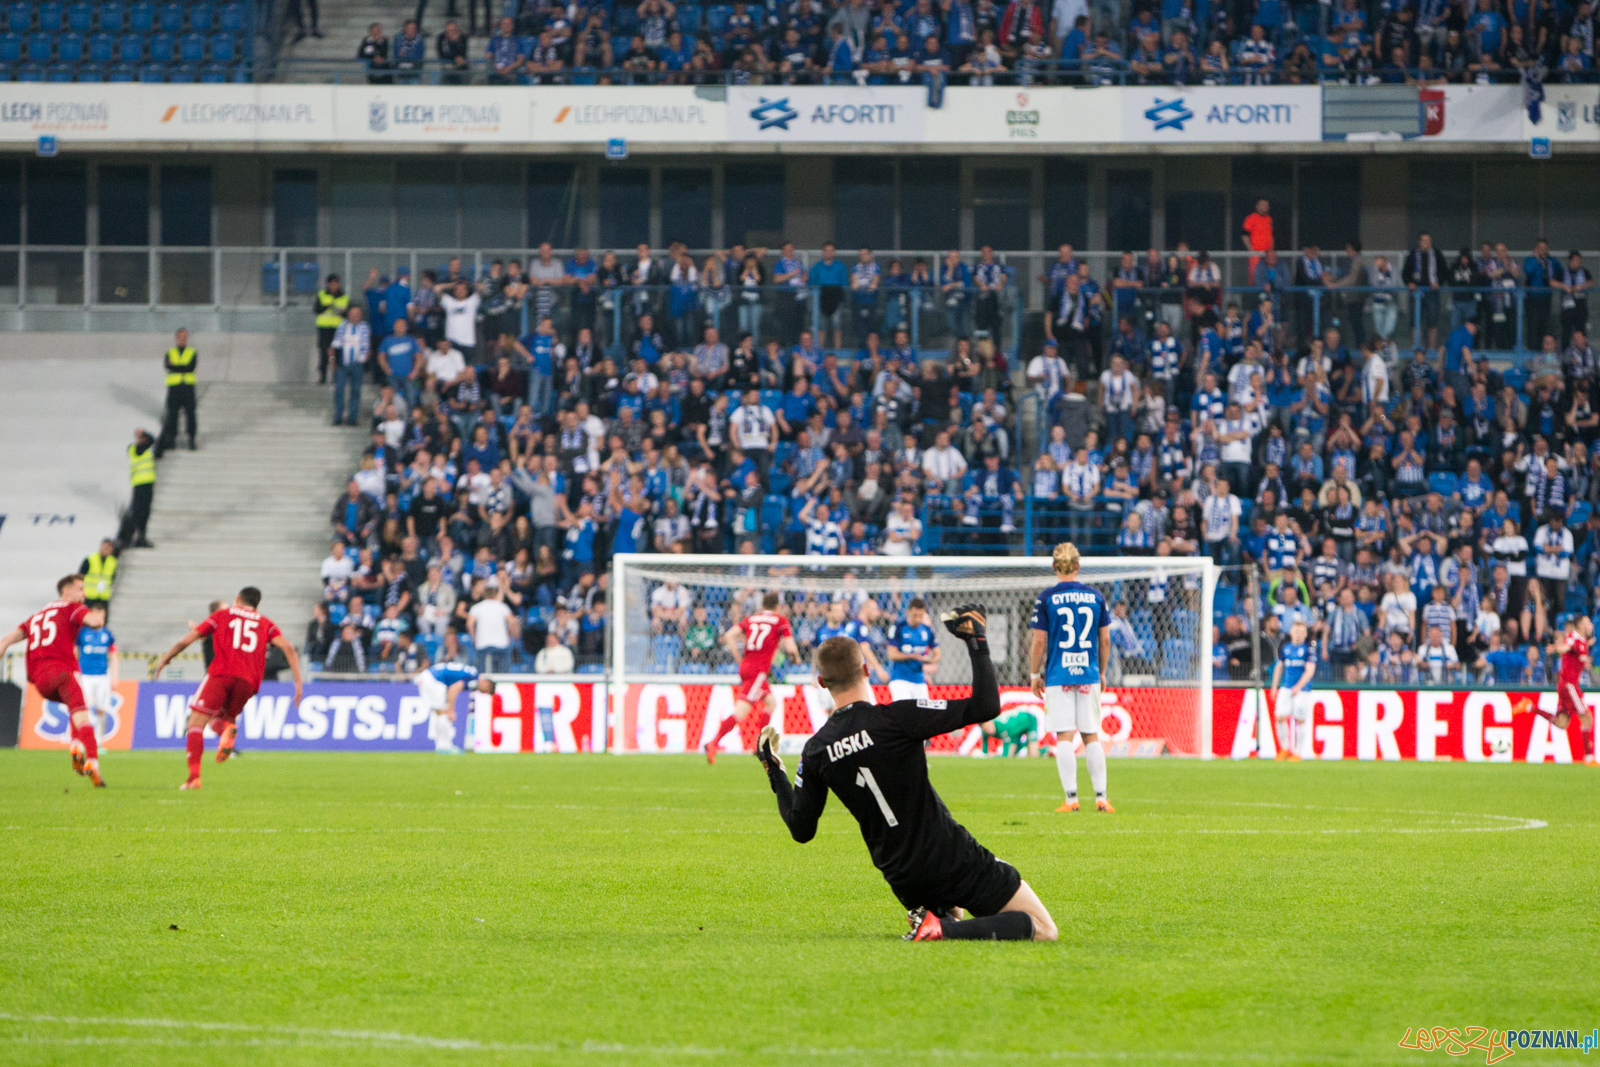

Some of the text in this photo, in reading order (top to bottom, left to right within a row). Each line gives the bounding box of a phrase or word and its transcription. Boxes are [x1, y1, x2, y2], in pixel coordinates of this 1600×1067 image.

[2, 102, 41, 121] LECH
[394, 104, 434, 123] LECH
[811, 104, 895, 123] AFORTI
[1206, 104, 1291, 123] AFORTI
[1052, 592, 1096, 605] GYTKJAER
[30, 609, 58, 651] 55
[229, 617, 259, 653] 15
[1057, 606, 1093, 649] 32
[1064, 656, 1087, 664] LECH
[154, 694, 456, 740] WW.STS.P
[826, 730, 874, 762] LOSKA
[856, 767, 899, 827] 1
